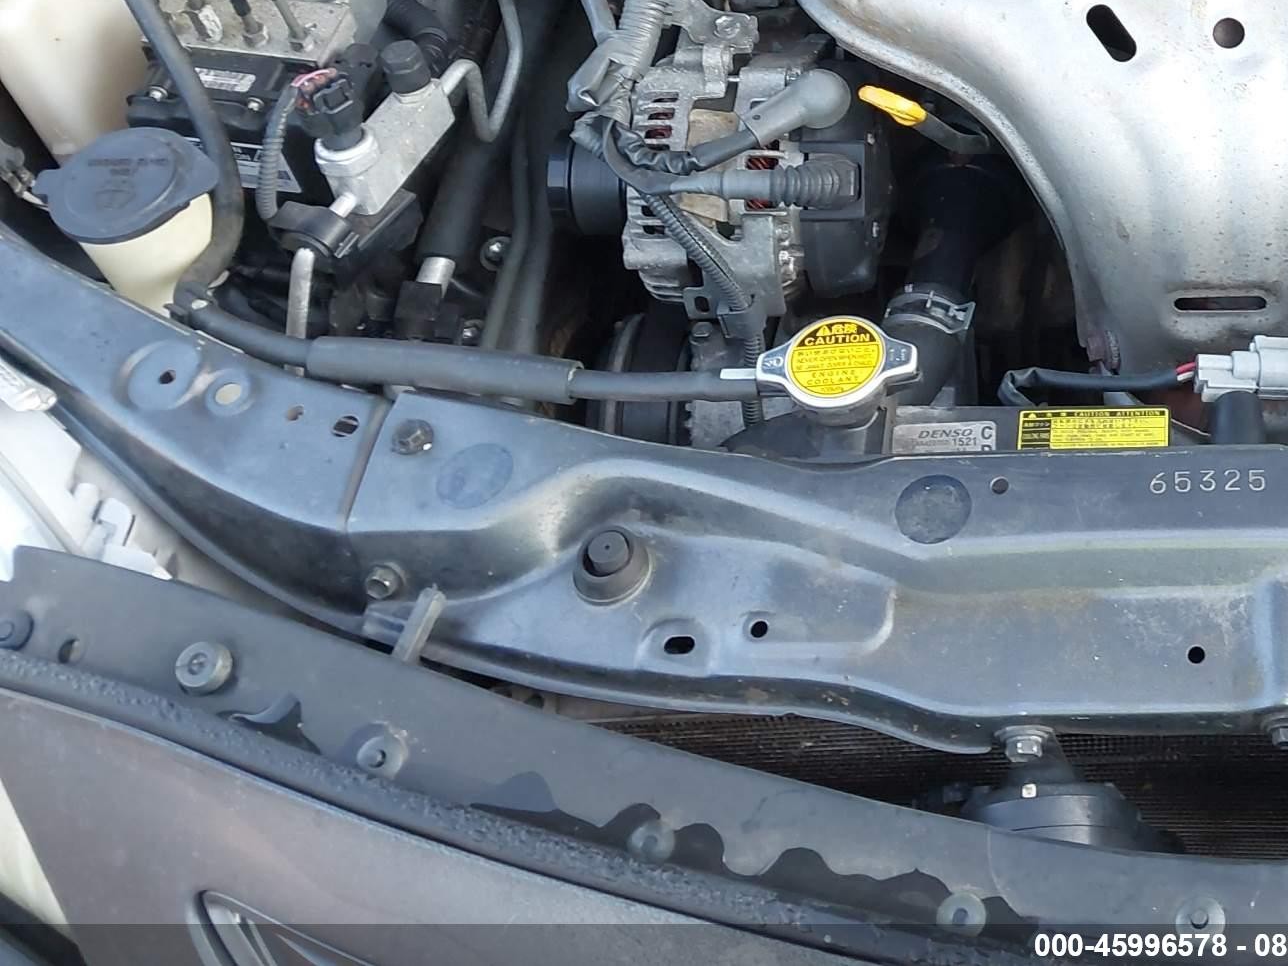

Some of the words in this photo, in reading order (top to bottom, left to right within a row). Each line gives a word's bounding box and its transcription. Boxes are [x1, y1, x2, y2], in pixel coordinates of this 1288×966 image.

[804, 334, 871, 347] CAUTION
[812, 369, 856, 379] ENGINE
[806, 375, 859, 386] COOLANT
[918, 428, 974, 439] DENSO
[981, 425, 993, 440] C
[1149, 469, 1266, 494] 65325
